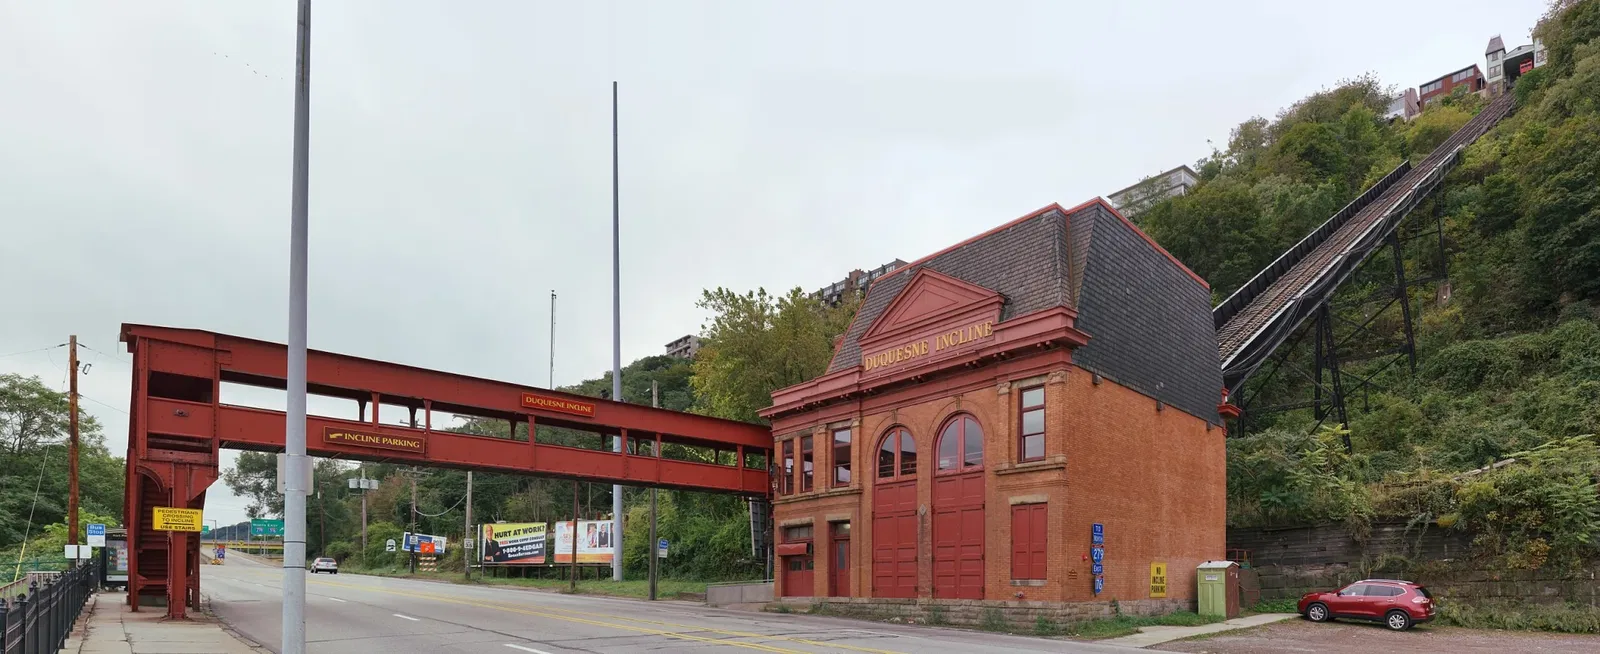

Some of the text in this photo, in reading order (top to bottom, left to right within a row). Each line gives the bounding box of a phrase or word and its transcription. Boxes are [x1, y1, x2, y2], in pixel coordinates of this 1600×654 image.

[865, 321, 992, 371] DUQUESNE INCLINE
[526, 396, 592, 412] DUQUESNE INCLINE
[344, 433, 420, 448] INCLINE PARKING
[494, 531, 511, 539] HURT
[522, 525, 545, 534] WORK?
[1094, 548, 1104, 560] 279
[1156, 567, 1161, 575] NO
